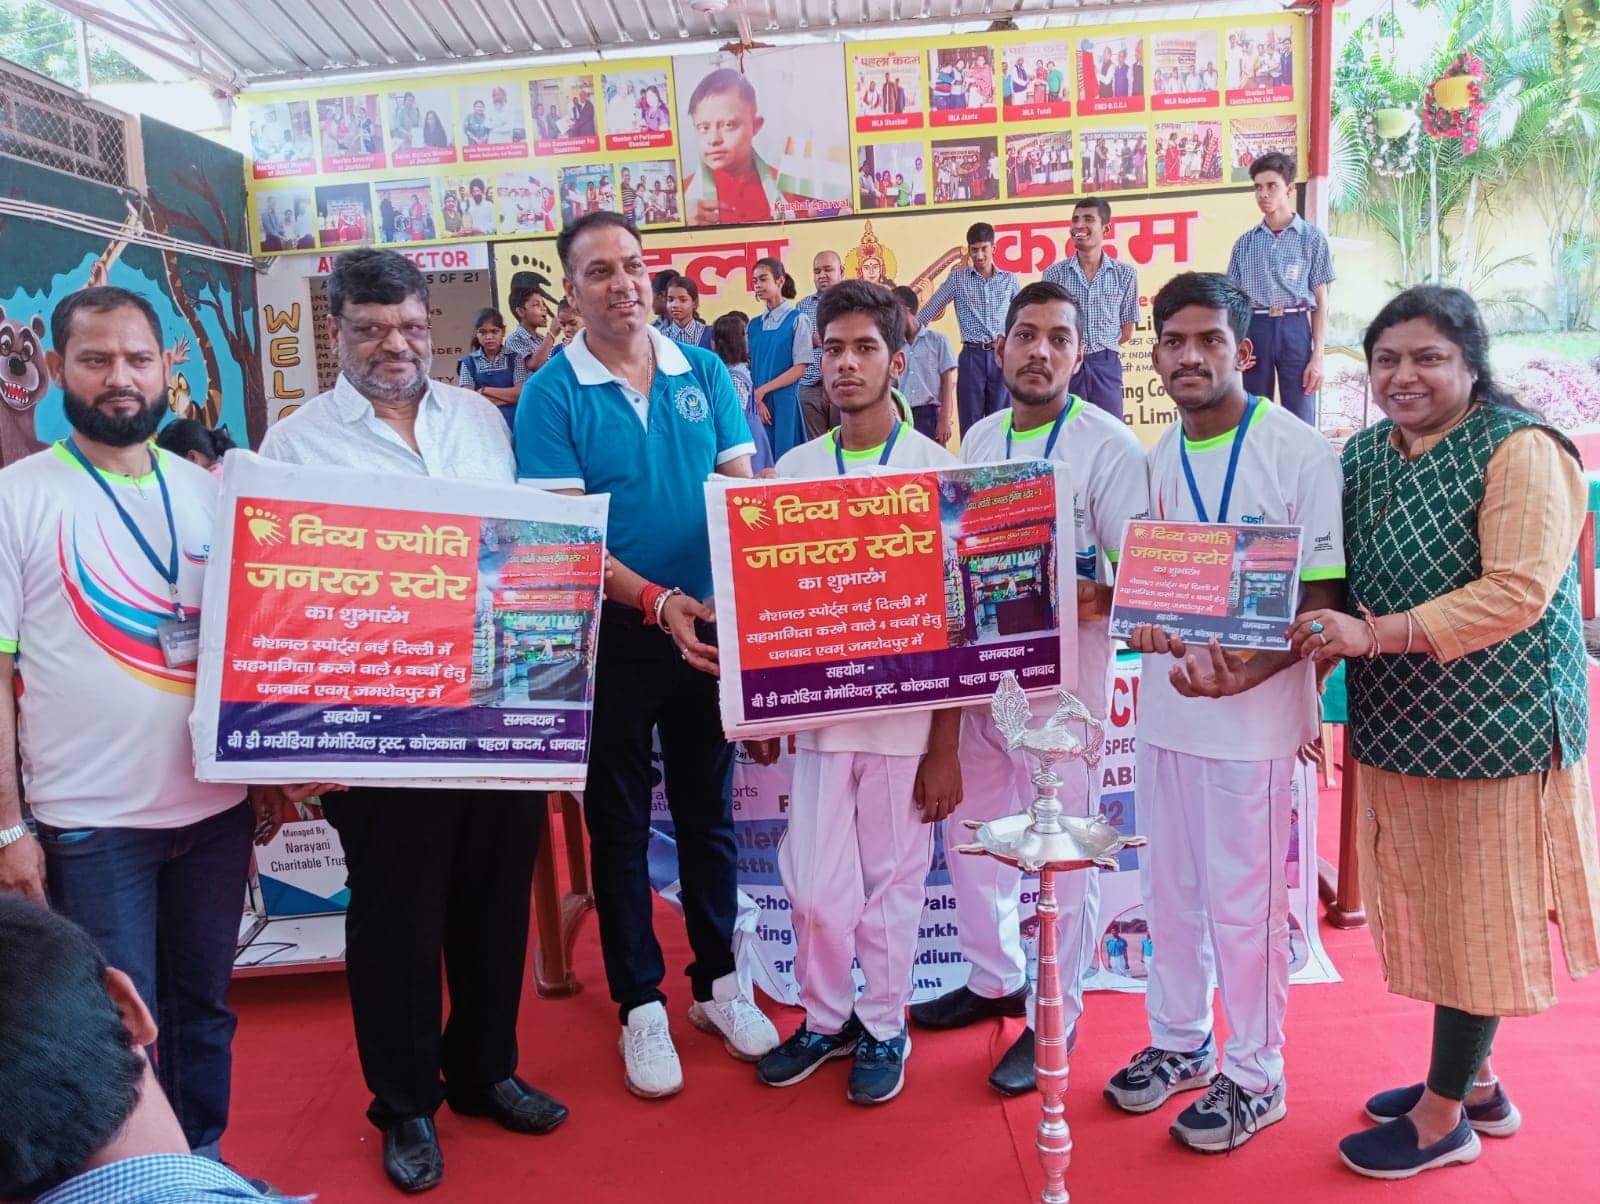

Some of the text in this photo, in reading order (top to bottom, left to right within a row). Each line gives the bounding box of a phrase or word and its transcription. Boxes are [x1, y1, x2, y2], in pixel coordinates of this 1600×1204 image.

[774, 199, 849, 212] Kaushal Agarwal
[440, 273, 457, 283] OF
[464, 272, 480, 282] 21
[1121, 384, 1144, 403] ing
[1140, 406, 1177, 424] Limi
[773, 495, 841, 525] दिव्य
[848, 484, 930, 518] ज्योति
[289, 514, 472, 558] दिव्य ज्योति
[742, 524, 937, 570] जनरल स्टोर
[243, 562, 472, 601] जनरल स्टोर
[798, 569, 887, 593] का शुभारंभ
[305, 605, 411, 629] का शुभारंभ
[759, 593, 928, 622] नेशनल स्पोर्ट्स नई दिल्ली में
[746, 614, 942, 644] सहभागिता करने वाले 4 बच्चों हेतु
[252, 636, 454, 656] नेशनल स्पोर्ट्स नई दिल्ली में
[768, 632, 925, 662] धनबाद एवम् जमशेदपुर में
[978, 646, 1025, 662] समन्वयन
[232, 657, 467, 682] सहभागिता करने वाले 4 बच्चों हेतु
[825, 664, 864, 678] सहयोग
[257, 682, 446, 703] धनबाद एवम् जमशेदपुर में
[752, 694, 764, 708] बी
[766, 692, 778, 708] डी
[780, 690, 822, 705] गरोडिया
[824, 685, 873, 700] मेमोरियल
[900, 678, 950, 694] कोलकाता
[959, 673, 986, 686] पहला
[1022, 664, 1056, 678] धनबाद
[323, 710, 370, 725] सहयोग
[503, 713, 556, 728] समन्वयन
[228, 734, 245, 749] बी
[247, 734, 263, 750] डी
[264, 733, 315, 750] गरोडिया
[318, 734, 376, 751] मेमोरियल
[410, 735, 467, 751] कोलकाता
[478, 738, 510, 752] पहला
[512, 738, 546, 752] कदम,
[550, 738, 586, 752] धनबाद
[1105, 738, 1136, 756] SPEC
[732, 785, 758, 798] orts
[282, 828, 315, 838] Managed
[285, 839, 332, 855] Narayani
[271, 856, 346, 873] Charitable Trus
